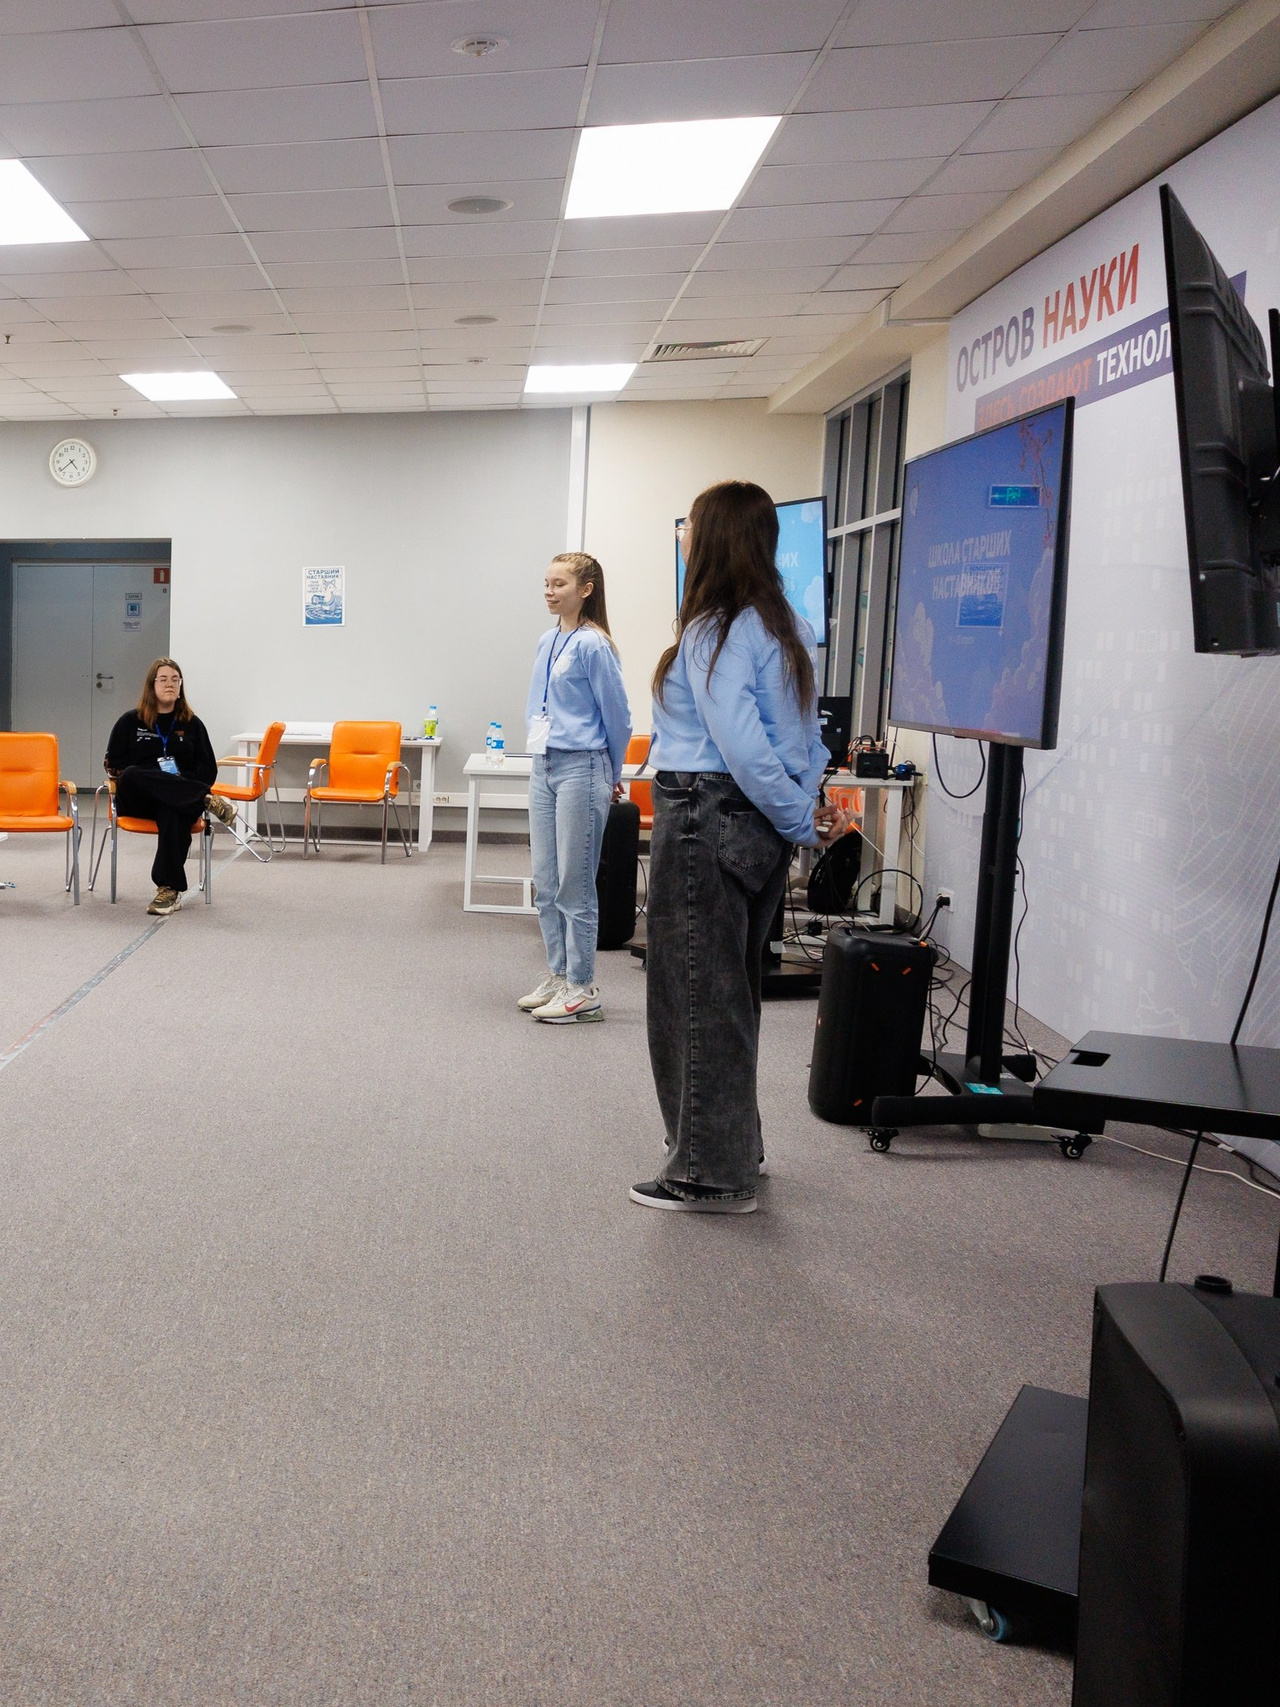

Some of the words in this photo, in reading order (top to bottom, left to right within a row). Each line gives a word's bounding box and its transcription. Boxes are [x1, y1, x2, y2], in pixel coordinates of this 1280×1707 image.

[956, 306, 1035, 393] ОСТРОВ
[1043, 243, 1140, 349] НАУКИ
[1019, 357, 1094, 412] СОЗДАЮТ
[928, 540, 961, 568] ШКОЛА
[962, 530, 1012, 563] СТАРШИХ
